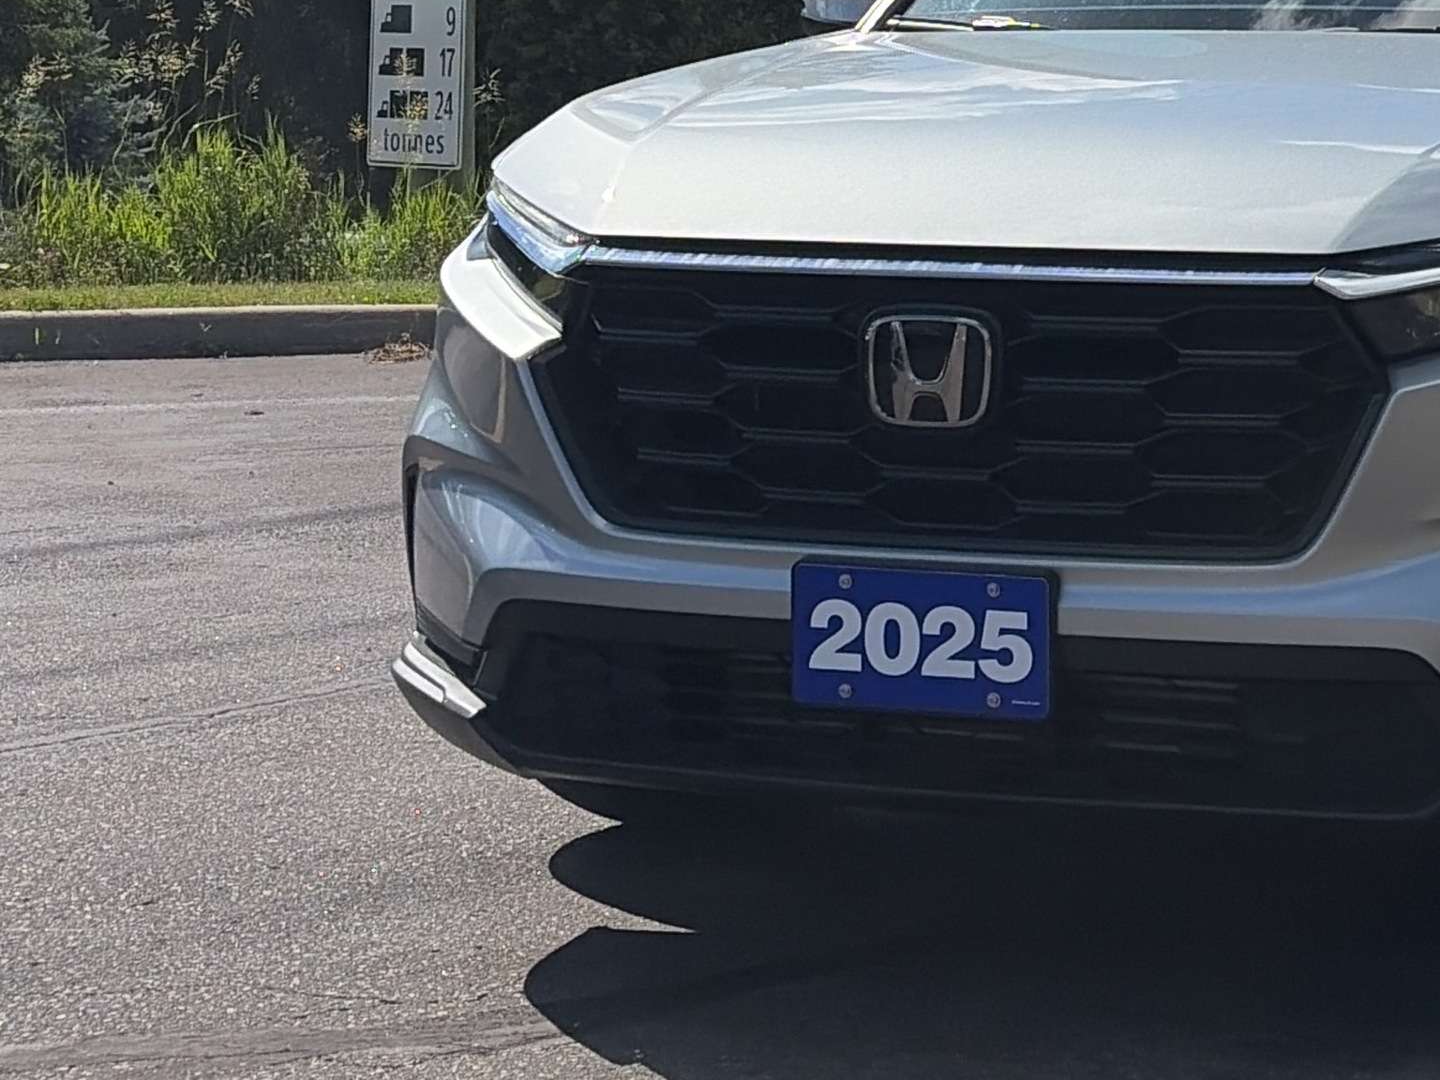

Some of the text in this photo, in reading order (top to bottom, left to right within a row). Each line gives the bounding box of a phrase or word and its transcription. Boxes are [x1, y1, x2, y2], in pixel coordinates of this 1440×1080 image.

[446, 6, 456, 37] 9
[439, 47, 456, 78] 17
[434, 90, 454, 120] 24
[383, 127, 445, 154] tonnes
[808, 598, 1033, 684] 2025
